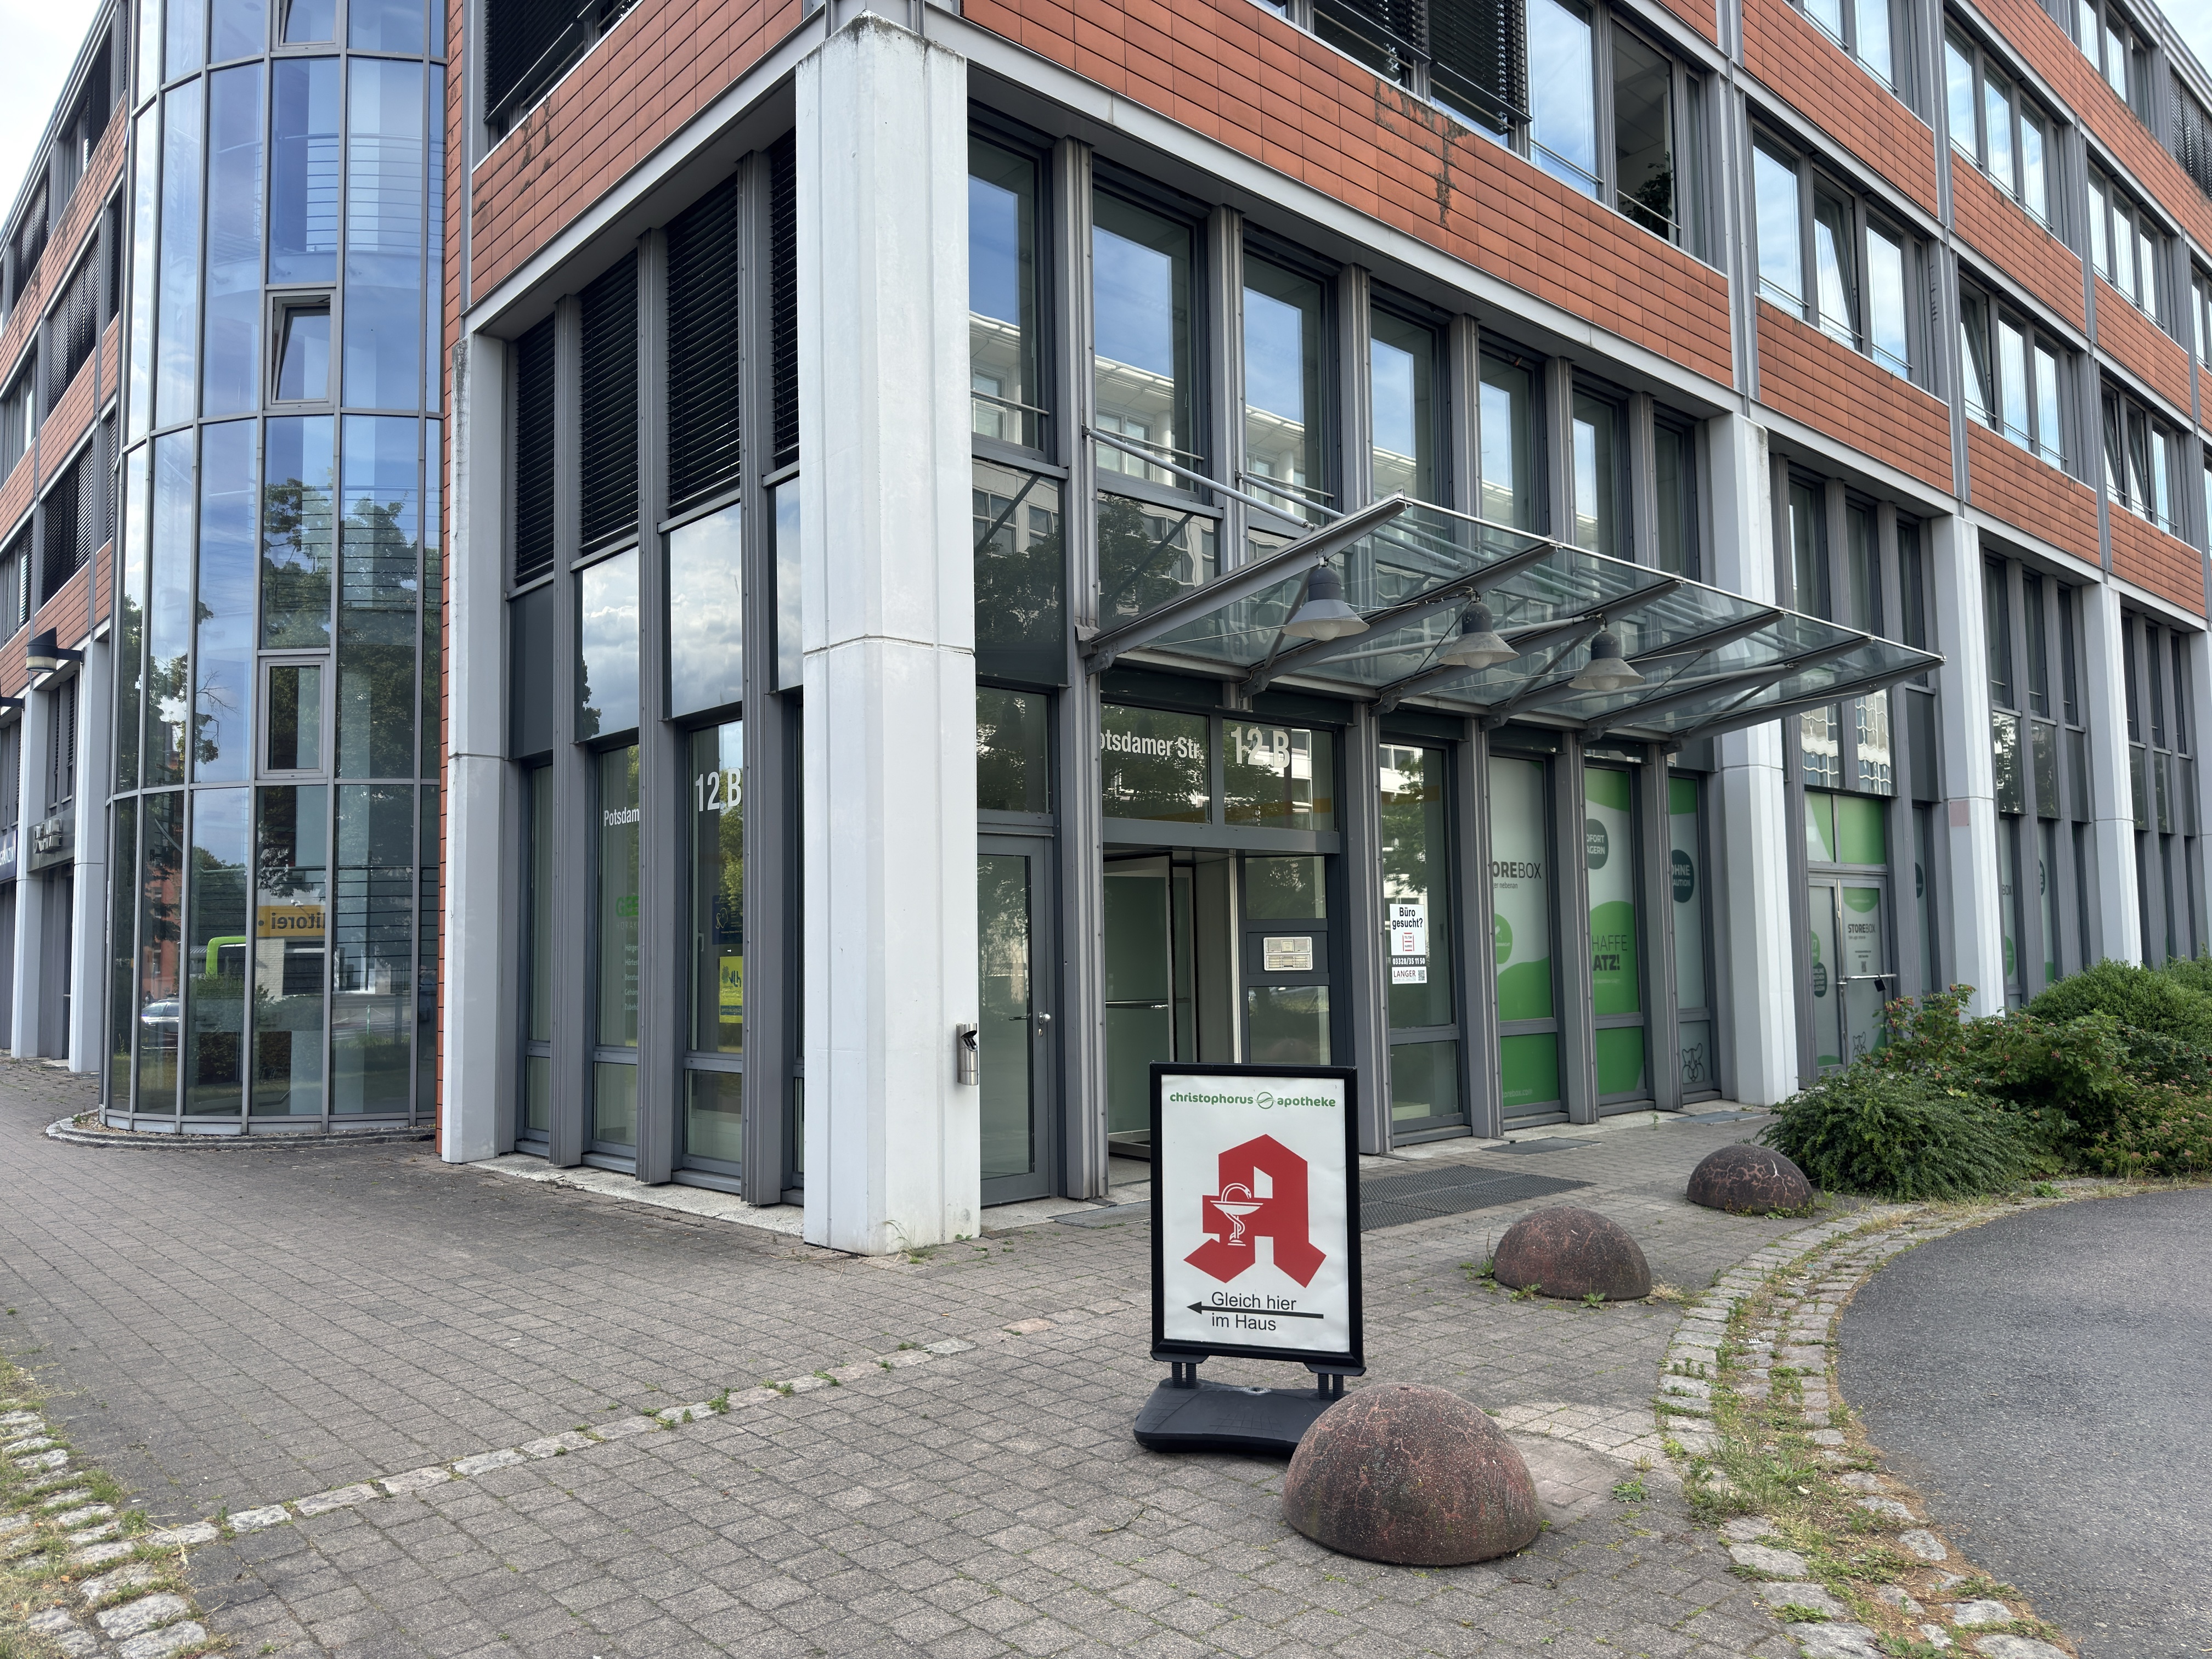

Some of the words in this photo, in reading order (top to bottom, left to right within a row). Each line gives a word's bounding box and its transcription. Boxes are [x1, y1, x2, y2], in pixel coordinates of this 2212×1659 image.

[1177, 736, 1204, 759] Str.
[1231, 726, 1264, 766] 12
[1273, 730, 1290, 768] B
[695, 771, 720, 812] 12
[727, 768, 742, 808] B
[604, 807, 639, 827] Potsdam
[1399, 907, 1415, 917] Büro
[1392, 918, 1423, 930] gesucht?
[1848, 924, 1876, 933] STOREBOX
[1592, 935, 1627, 951] HAFFE
[1593, 954, 1620, 971] ATZ!
[1170, 1092, 1254, 1105] christophorus
[1277, 1096, 1336, 1108] apotheke
[1211, 1291, 1261, 1308] Gleich
[1267, 1295, 1297, 1311] hier
[1212, 1313, 1229, 1328] im
[1235, 1314, 1277, 1331] Haus
